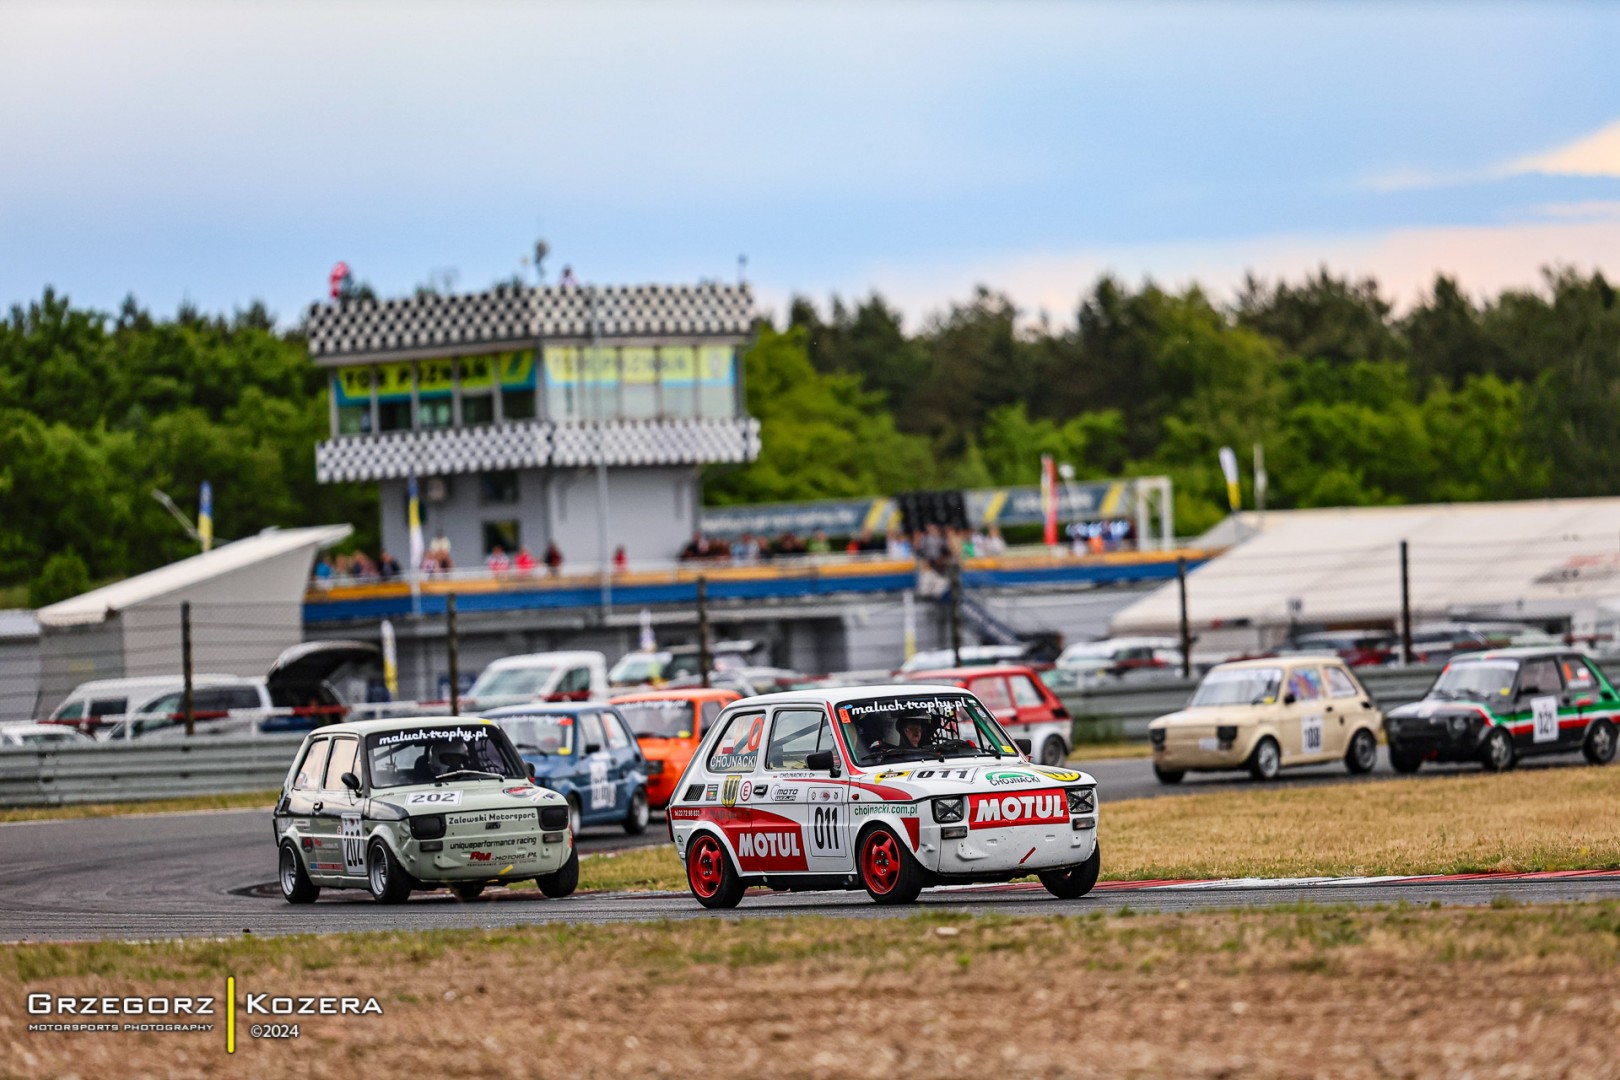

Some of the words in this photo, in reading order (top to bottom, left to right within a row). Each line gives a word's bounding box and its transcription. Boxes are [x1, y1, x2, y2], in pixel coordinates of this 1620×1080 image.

[851, 697, 968, 715] maluch-trophy.pl
[379, 727, 488, 745] maluch-trophy.pl
[710, 756, 757, 768] CHOJNACKI
[917, 770, 968, 779] 011
[989, 776, 1041, 786] CHOJNACKI
[411, 793, 455, 803] 202
[854, 804, 918, 816] chojnacki.com.pl
[974, 795, 1065, 822] MOTUL
[448, 815, 487, 825] Zalewski
[489, 812, 536, 821] Motorsport
[814, 806, 839, 850] 011
[343, 828, 364, 867] 202
[450, 838, 516, 850] uniqueperformance
[516, 836, 537, 846] racing
[739, 832, 800, 857] MOTUL
